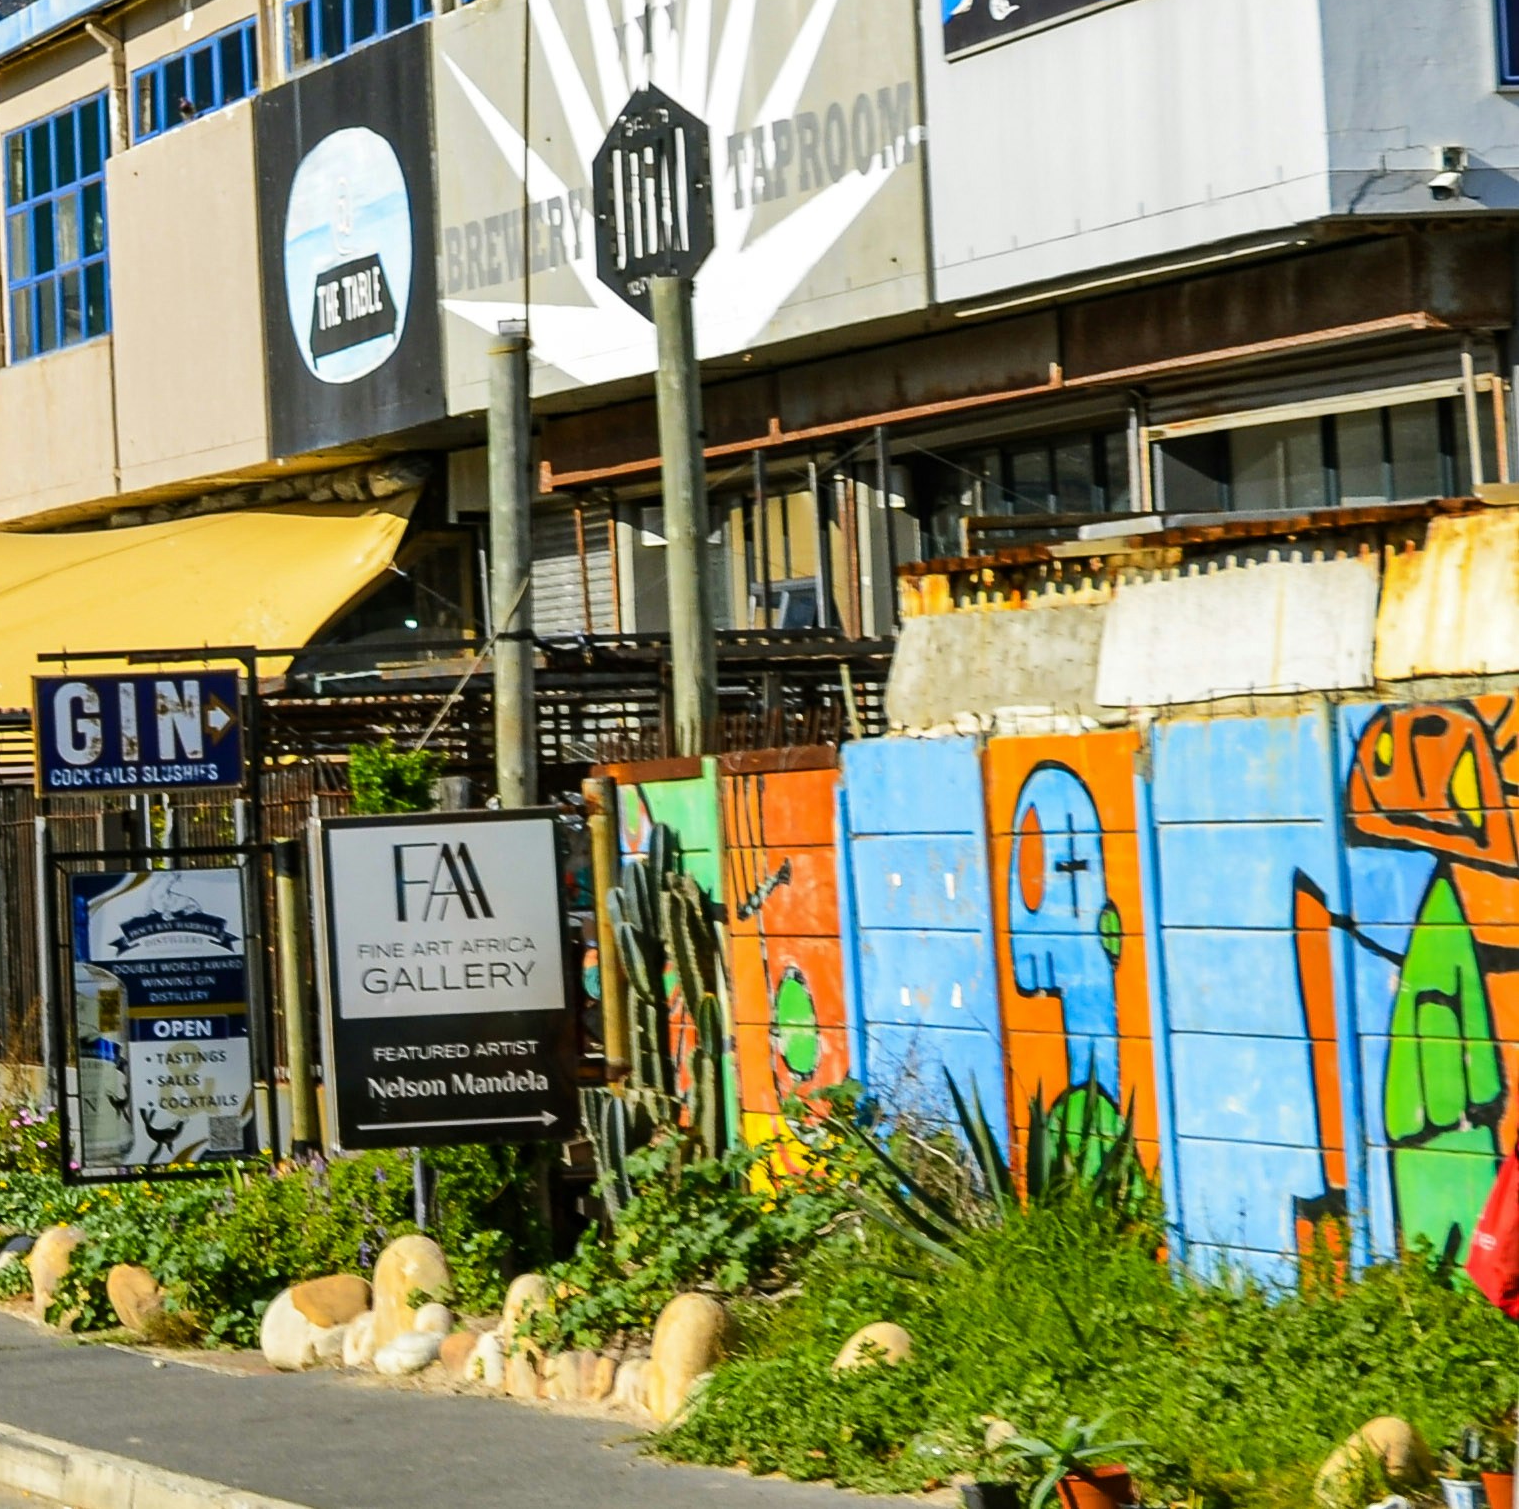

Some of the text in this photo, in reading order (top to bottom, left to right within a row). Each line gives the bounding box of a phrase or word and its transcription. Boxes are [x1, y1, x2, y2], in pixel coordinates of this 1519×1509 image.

[727, 82, 913, 210] TAPROOM
[445, 188, 584, 295] BREWERY
[317, 266, 383, 330] THE TABLE
[54, 680, 204, 765] GIN
[50, 766, 137, 786] COCKTAILS
[358, 937, 537, 958] FINE ART AFRICA
[113, 959, 243, 974] DOUBLE WORLD AWARD
[141, 976, 216, 987] WINNING GIN
[362, 961, 536, 994] GALLERY
[149, 991, 209, 1002] DISTILLERY
[153, 1020, 212, 1038] OPEN
[156, 1050, 227, 1064] TASTINGS
[373, 1040, 539, 1062] FEATURED ARTIST
[157, 1074, 200, 1087] SALES
[368, 1070, 549, 1099] Nelson Mandela
[159, 1094, 239, 1109] COCKTAILS
